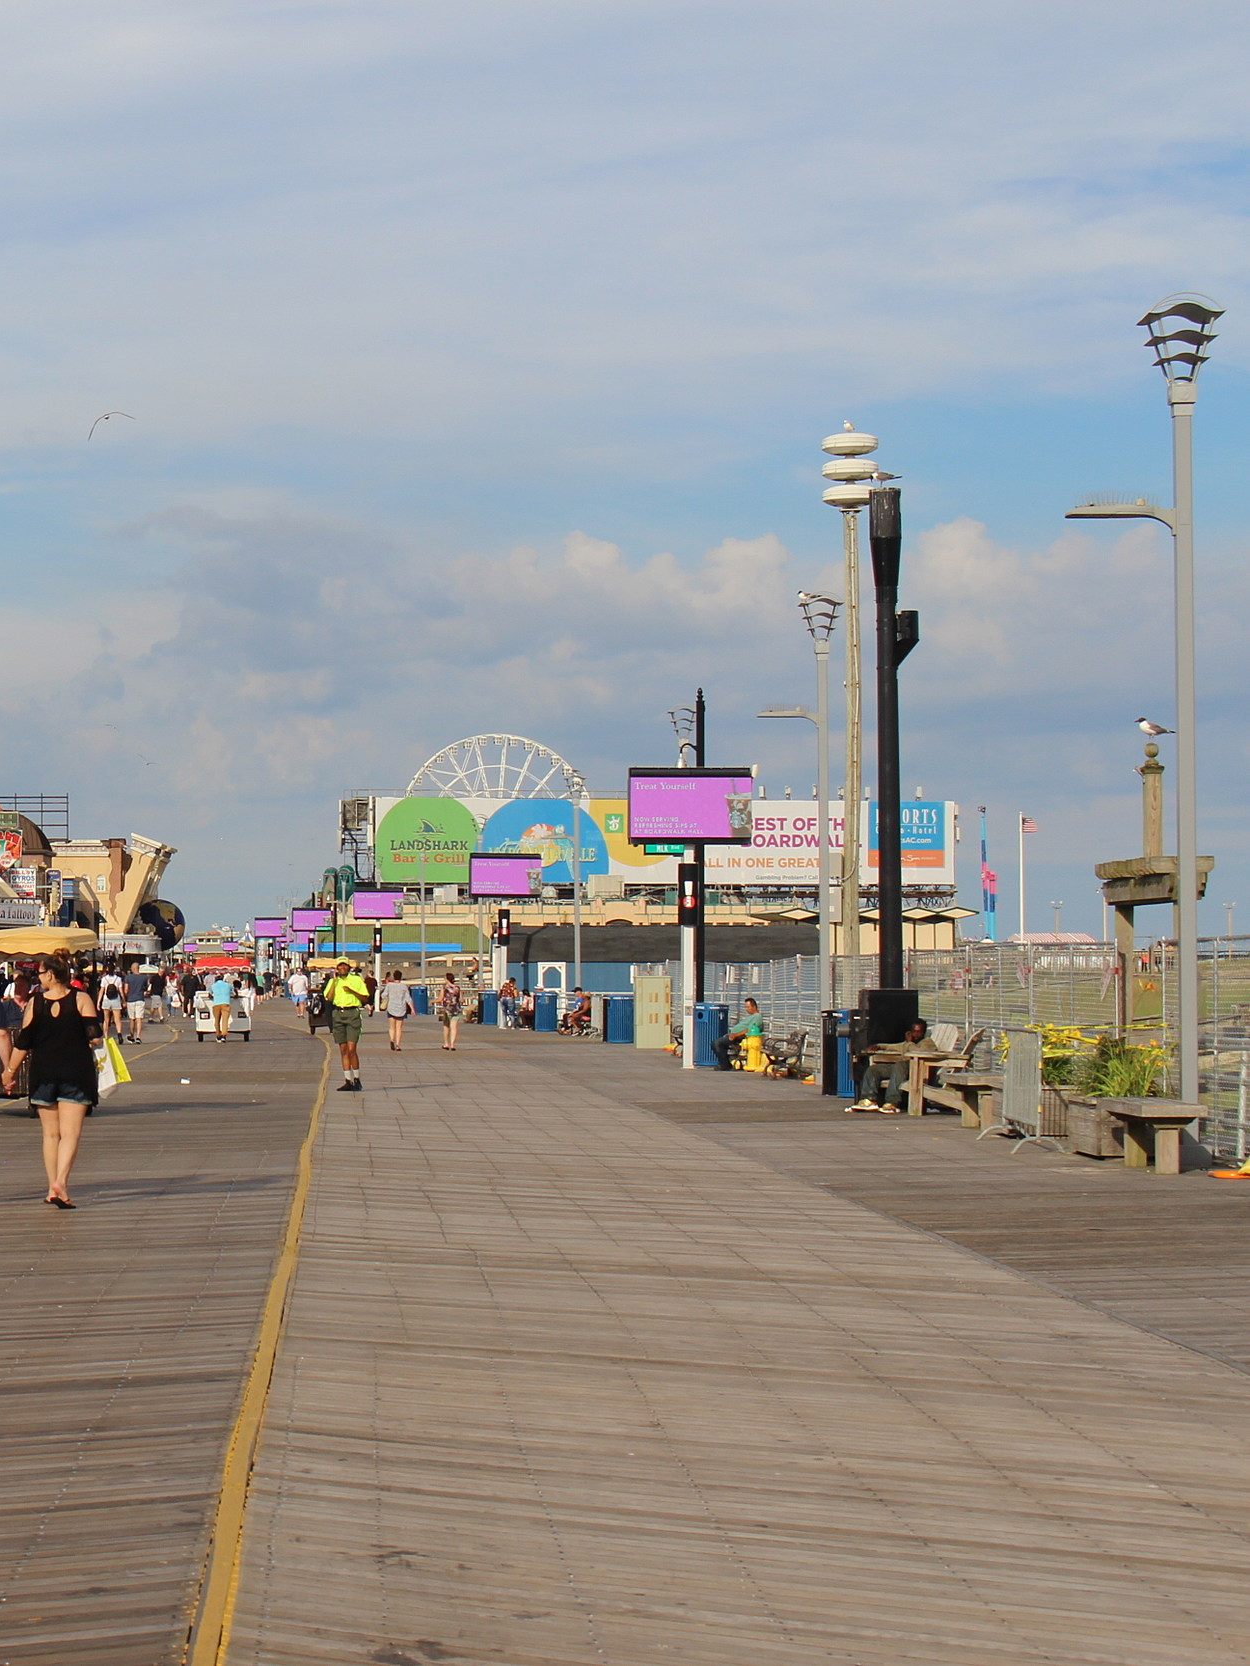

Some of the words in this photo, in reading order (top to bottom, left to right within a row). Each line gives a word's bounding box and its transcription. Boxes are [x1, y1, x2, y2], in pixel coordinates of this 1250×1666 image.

[634, 782, 656, 790] Treat
[660, 782, 696, 790] Yourself
[751, 817, 787, 831] EST
[793, 817, 817, 831] OF
[912, 826, 937, 834] Hotel
[390, 839, 468, 850] LANDSHARK
[393, 854, 416, 863] Bar
[434, 854, 465, 863] Grill
[728, 858, 742, 868] IN
[745, 858, 774, 868] ONE
[778, 858, 821, 868] GREAT
[7, 907, 35, 920] Tattoos
